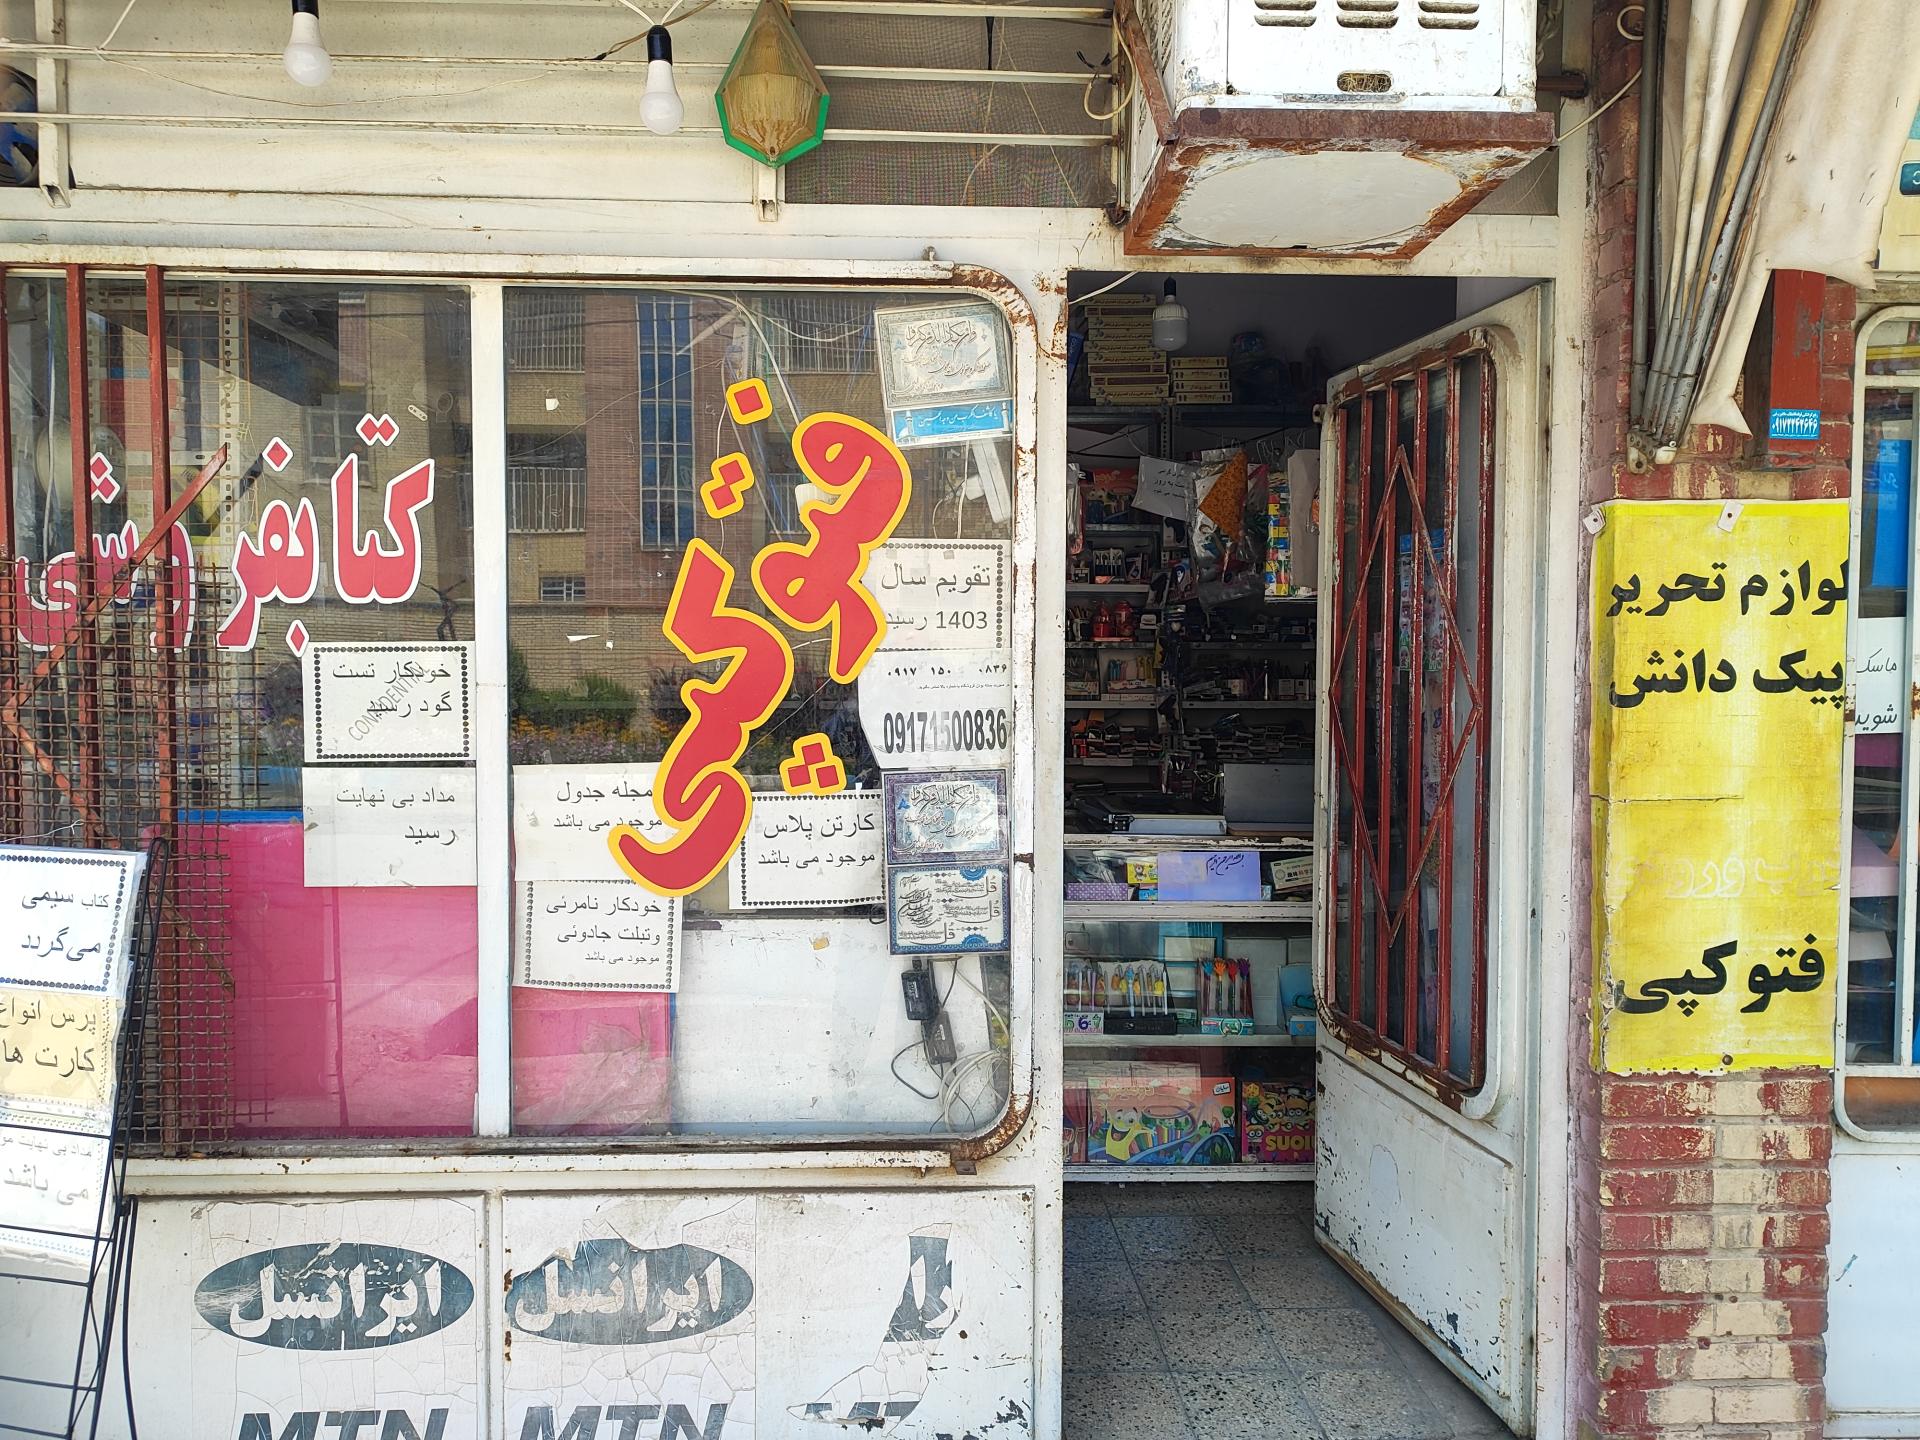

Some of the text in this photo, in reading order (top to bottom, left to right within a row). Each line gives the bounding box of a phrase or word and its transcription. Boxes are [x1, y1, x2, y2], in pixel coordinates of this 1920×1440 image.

[881, 563, 991, 596] تقویم سال
[1607, 559, 1849, 618] لوازم تحریر
[886, 610, 988, 630] 1403 رسید
[333, 661, 451, 684] خودکار تست
[887, 666, 917, 677] ۰۹۱۷
[931, 665, 952, 676] ۱۵۰
[1610, 647, 1846, 710] پیک دانش
[367, 691, 452, 718] گود رسید
[883, 709, 1008, 754] 09171500836
[336, 787, 455, 809] مداد بی نهایت
[557, 781, 653, 802] مجله جدول
[553, 814, 583, 830] باشد
[589, 820, 610, 832] می
[763, 814, 813, 840] پلاس
[404, 825, 457, 845] رسید
[758, 850, 875, 869] موجود می باشد
[21, 891, 110, 910] کتاب سیمی
[605, 896, 662, 915] خودکار
[584, 951, 660, 966] موجود می باشد
[50, 1012, 97, 1035] پرس
[3, 1038, 95, 1078] کارت ها
[18, 1135, 48, 1152] نهایت
[52, 1145, 67, 1156] بی
[71, 1143, 93, 1157] مداد
[4, 1163, 89, 1206] می باشد
[229, 1258, 442, 1338] ایرانسل
